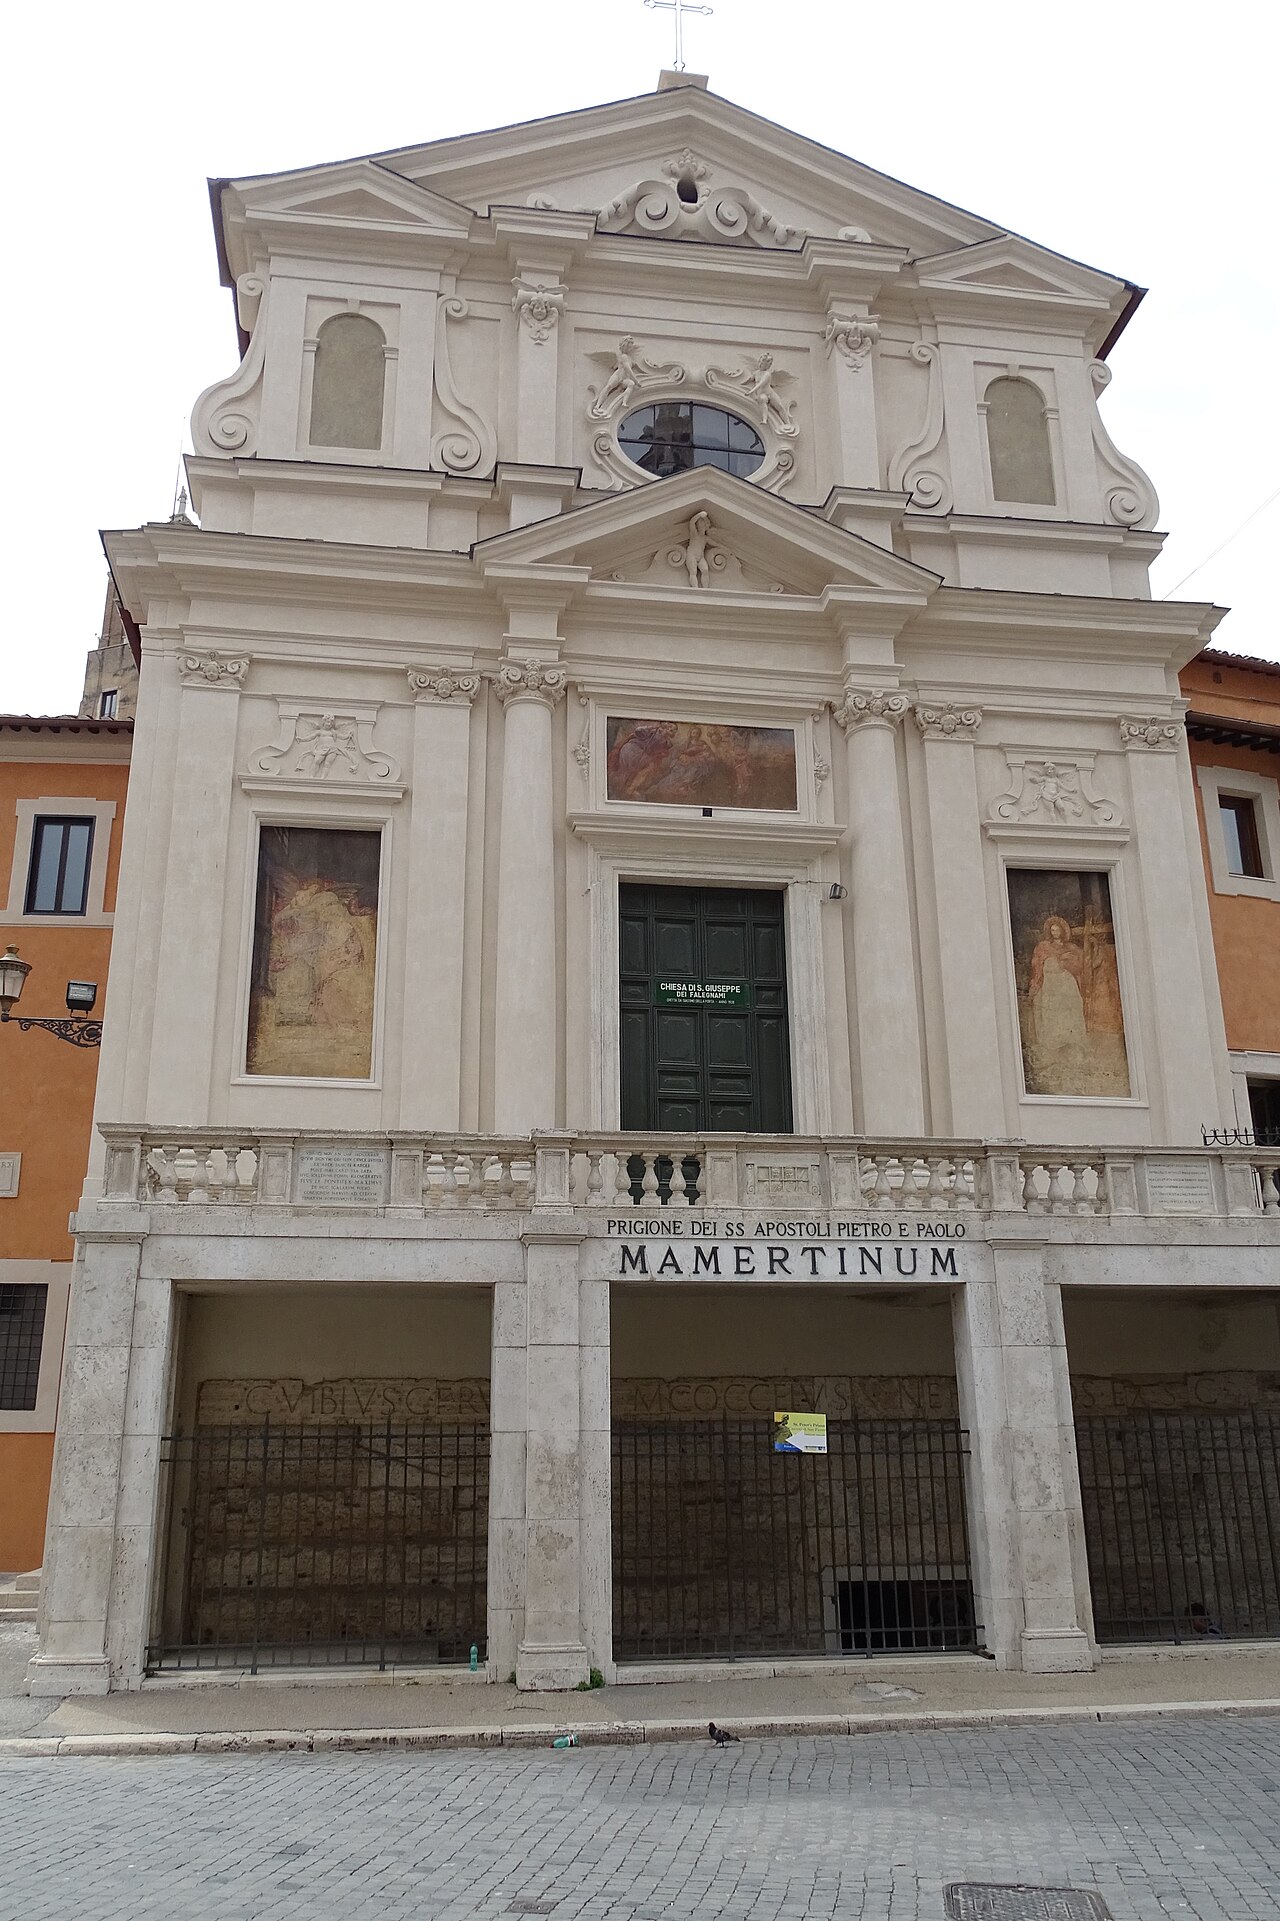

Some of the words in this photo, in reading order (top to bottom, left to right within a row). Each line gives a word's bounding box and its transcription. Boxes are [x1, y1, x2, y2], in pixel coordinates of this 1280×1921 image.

[660, 983, 687, 991] CHIESA
[697, 984, 705, 992] S.
[705, 985, 741, 993] GIUSEPPE
[606, 1219, 684, 1236] PRIGIONE
[690, 1220, 718, 1237] DEI
[725, 1222, 746, 1237] SS
[754, 1221, 831, 1238] APOSTOLI
[836, 1222, 892, 1238] PIETRO
[898, 1223, 910, 1238] E
[916, 1223, 966, 1238] PAOLO
[618, 1244, 959, 1277] MAMERTINUM
